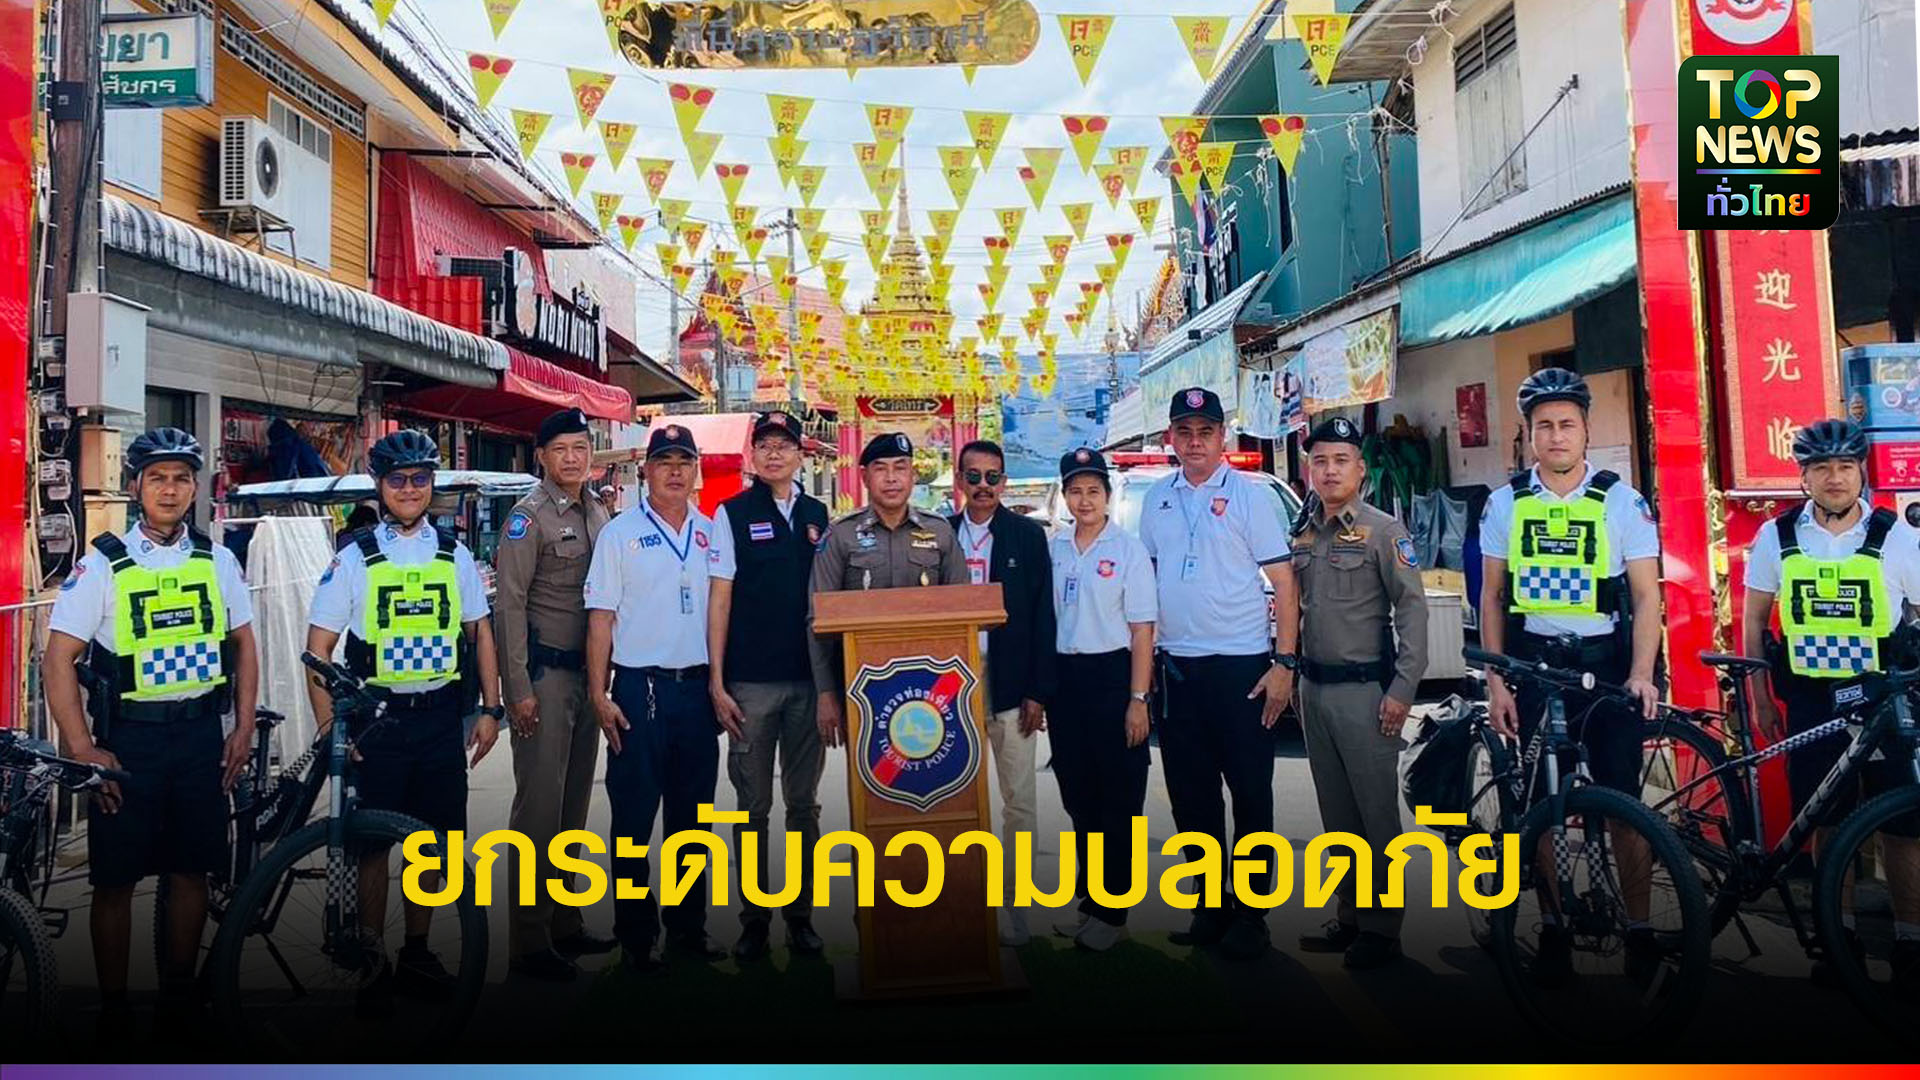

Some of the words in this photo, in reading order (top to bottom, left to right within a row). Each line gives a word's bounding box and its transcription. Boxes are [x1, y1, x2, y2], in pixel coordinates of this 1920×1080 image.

[1751, 230, 1803, 461] 迎光临
[875, 686, 954, 730] ตำรวจท่องเที่ยว
[878, 735, 921, 771] TOURIST
[926, 730, 957, 769] POLICE
